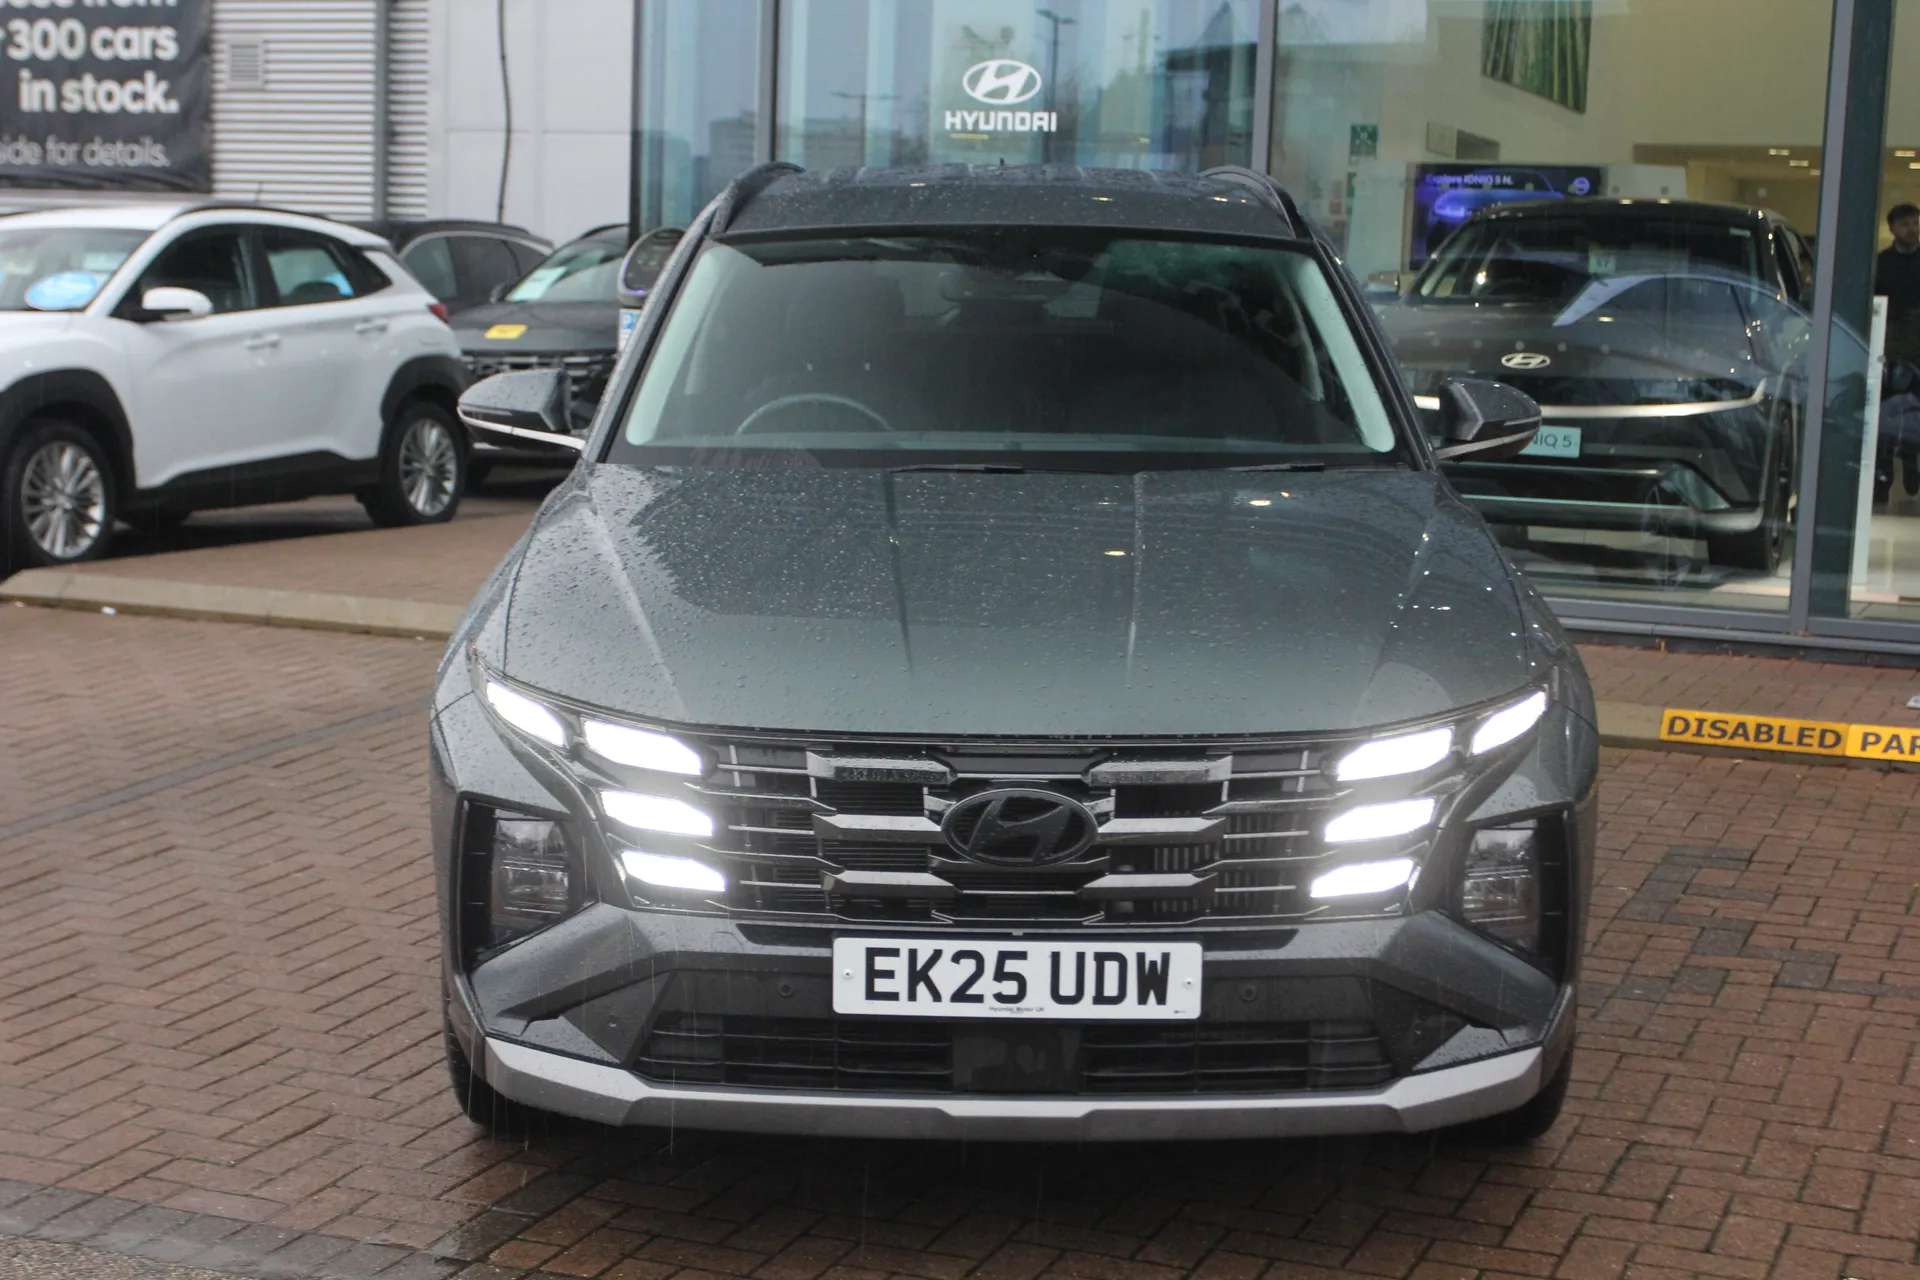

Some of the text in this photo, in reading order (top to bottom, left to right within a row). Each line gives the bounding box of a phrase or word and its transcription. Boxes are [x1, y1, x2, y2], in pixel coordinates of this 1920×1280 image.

[7, 18, 86, 60] 300
[91, 26, 179, 60] cars
[19, 68, 180, 113] in stock.
[944, 110, 1058, 132] HYUNDAI
[0, 133, 42, 165] ide
[46, 134, 80, 166] for
[1562, 433, 1572, 448] 5
[1666, 715, 1842, 749] DISABLED
[865, 946, 1171, 1006] EK25 UDW
